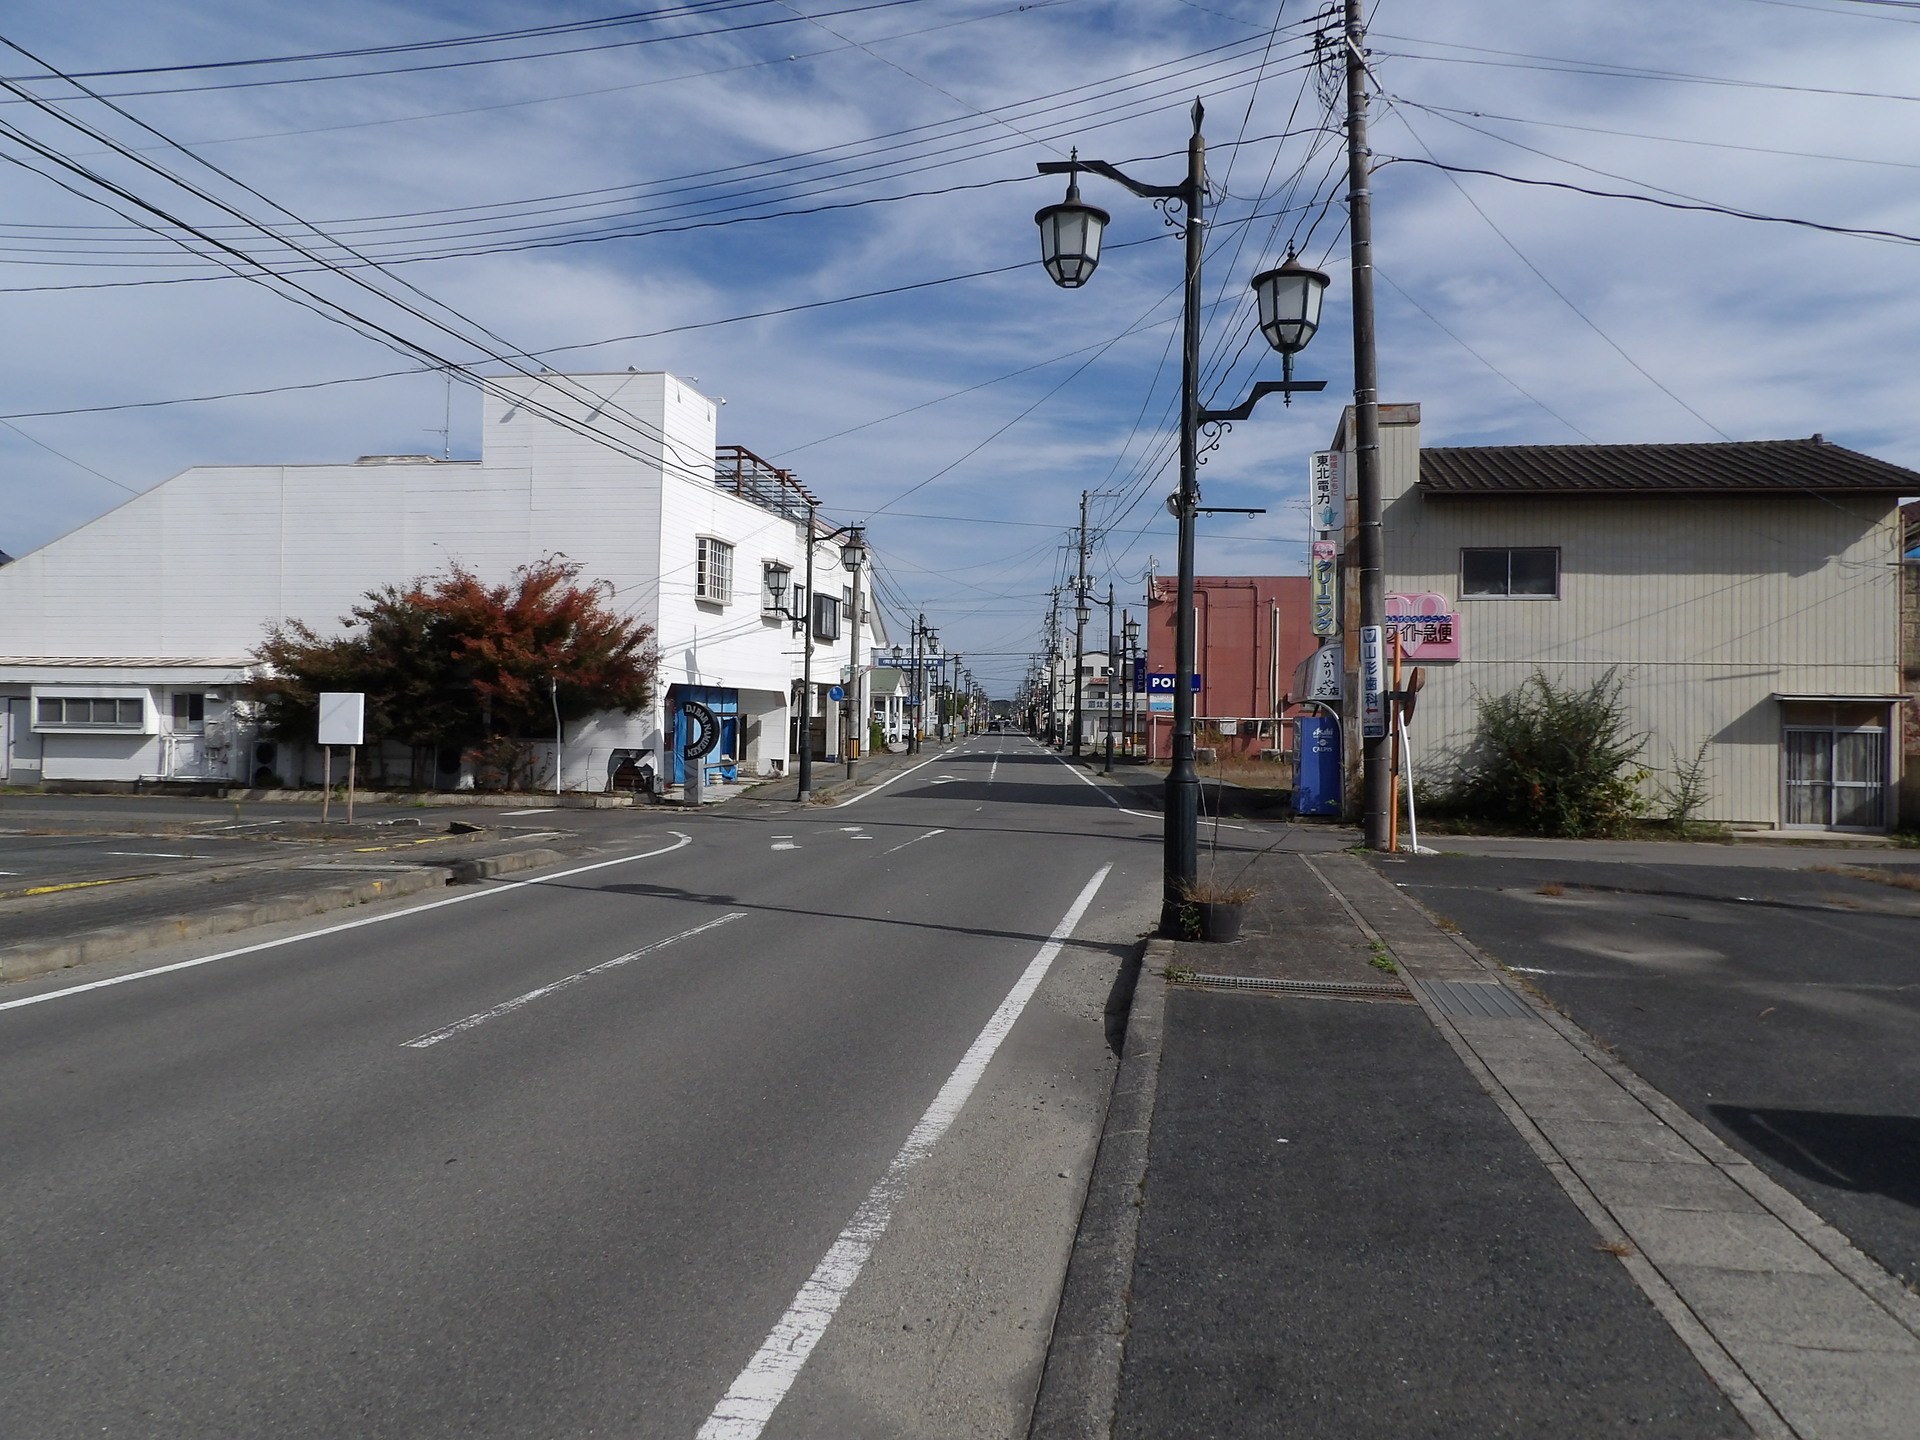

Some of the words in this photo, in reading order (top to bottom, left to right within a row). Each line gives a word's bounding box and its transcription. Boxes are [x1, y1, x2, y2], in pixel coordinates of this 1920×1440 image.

[1316, 455, 1330, 505] 東北電力
[1315, 560, 1333, 631] クリーニング
[1385, 623, 1453, 643] ワイト急便
[1322, 653, 1335, 687] いかりや
[1363, 645, 1377, 707] 山形歯科
[1152, 677, 1175, 689] PO
[1315, 687, 1340, 696] 支店
[685, 704, 696, 713] DJ
[694, 708, 709, 724] BAR
[687, 723, 712, 757] NAMIEKEN
[1313, 727, 1333, 736] Asahi
